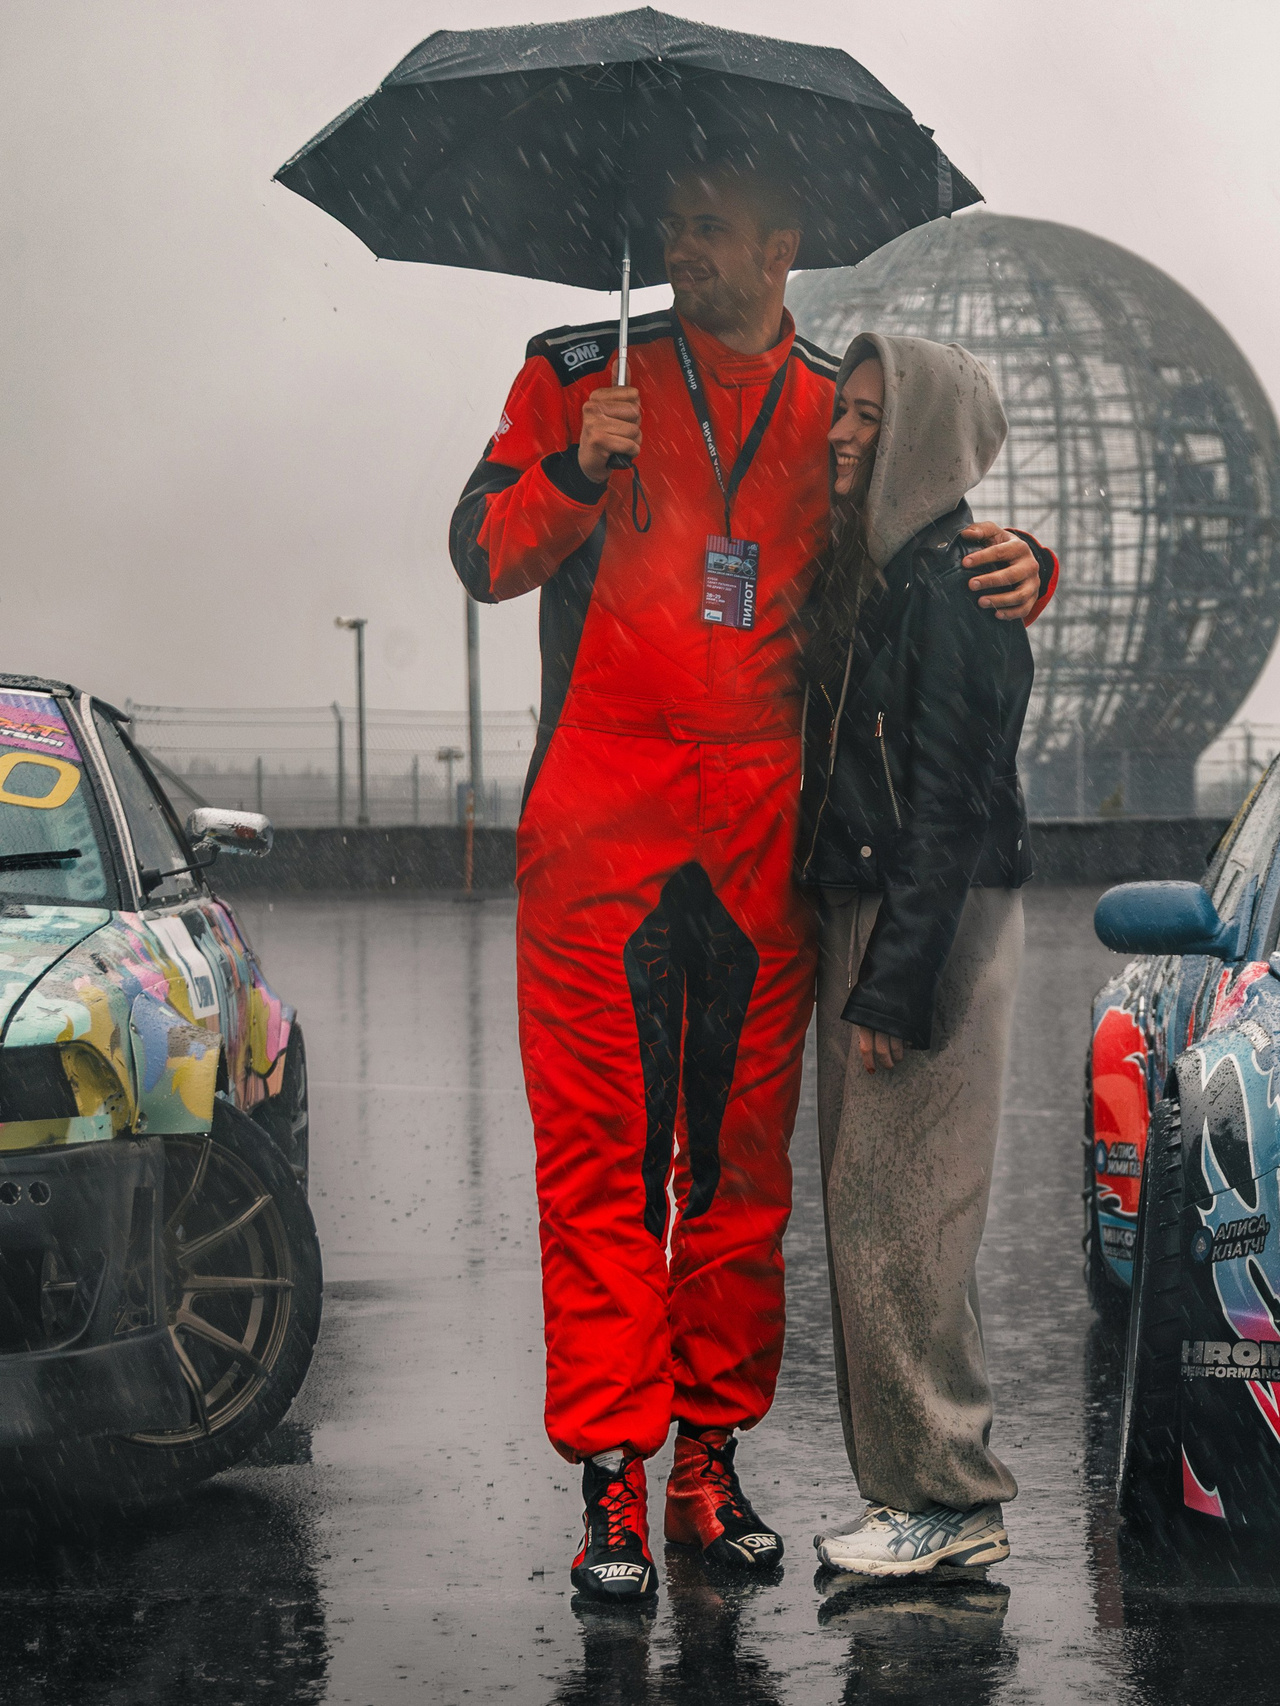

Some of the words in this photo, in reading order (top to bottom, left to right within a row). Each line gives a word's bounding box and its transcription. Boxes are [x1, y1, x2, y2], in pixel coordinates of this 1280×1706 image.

[563, 344, 600, 367] OMP
[702, 420, 717, 457] ДРАЙВ
[742, 581, 754, 627] ПИЛОТ
[1215, 1216, 1270, 1241] АЛИСА,
[1212, 1236, 1264, 1260] КЛАТЧ!
